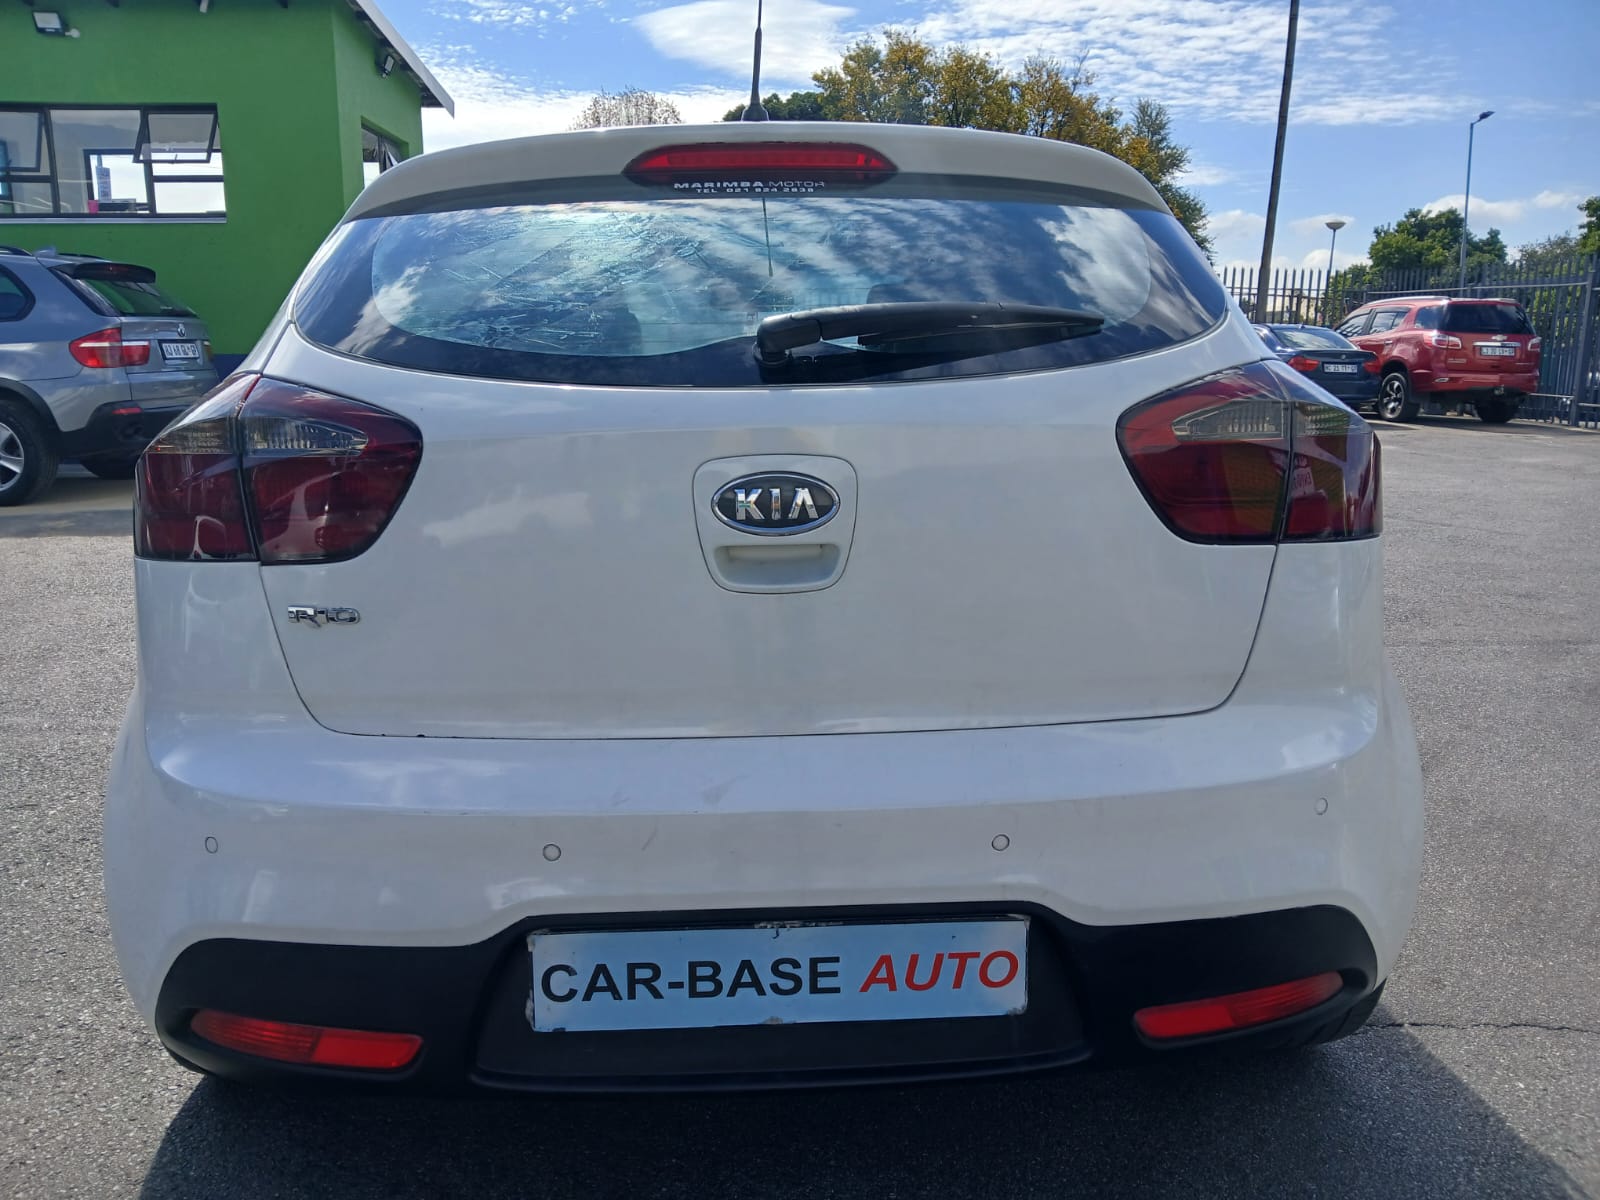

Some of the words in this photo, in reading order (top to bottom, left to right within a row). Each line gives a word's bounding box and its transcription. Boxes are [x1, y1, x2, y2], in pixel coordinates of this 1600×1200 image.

[673, 181, 764, 189] MARIMBA
[734, 487, 819, 520] KIA
[287, 605, 360, 628] RIO
[540, 956, 841, 1002] CAR-BASE
[859, 950, 1019, 993] AUTO
